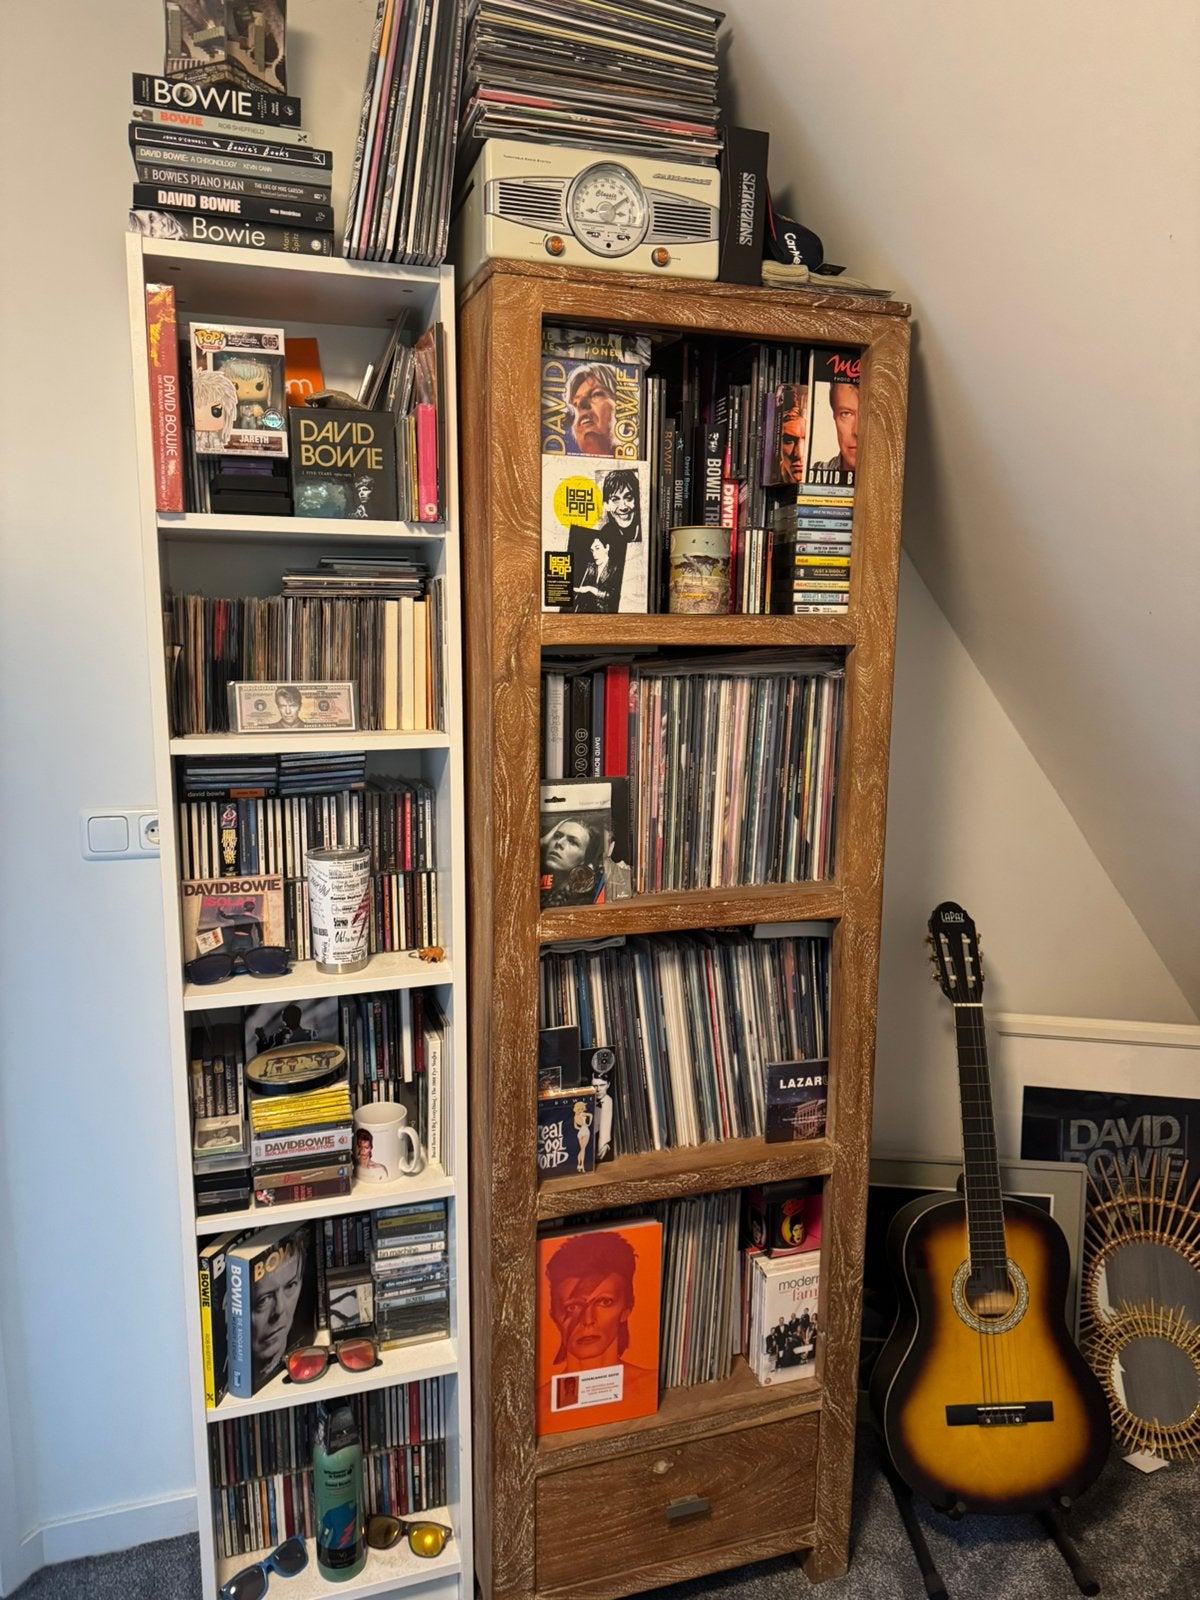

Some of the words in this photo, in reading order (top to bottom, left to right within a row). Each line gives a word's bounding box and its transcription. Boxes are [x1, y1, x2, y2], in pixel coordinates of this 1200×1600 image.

[154, 79, 252, 116] BOWIE
[160, 111, 203, 127] BOWIE
[218, 122, 231, 131] ROB
[232, 124, 265, 135] SHEFFIELD
[140, 148, 161, 158] DAVID
[196, 156, 238, 168] CHRONOLOGY
[263, 145, 289, 158] Books
[243, 163, 258, 171] KEVIN
[259, 165, 273, 173] CANN
[191, 174, 221, 188] PIANO
[224, 179, 244, 192] MAN
[158, 190, 196, 208] DAVID
[200, 195, 241, 215] BOWIE
[740, 172, 757, 246] SCORPIONS
[192, 216, 266, 247] Bowie
[195, 329, 225, 345] POP!
[263, 336, 278, 347] 365
[585, 347, 623, 358] JONES
[163, 375, 177, 412] DAVID
[543, 361, 566, 456] DAVID
[615, 367, 639, 460] BOWIE
[164, 414, 178, 456] BOWIE
[239, 434, 269, 444] JARETH
[300, 419, 374, 445] DAVID
[301, 444, 383, 470] BOWIE
[706, 458, 722, 502] BOWIE
[808, 470, 840, 484] DAVID
[675, 479, 684, 510] BOWIE
[188, 790, 205, 798] david
[184, 879, 281, 897] DAVIDBOWIE
[265, 1135, 335, 1153] DAVIDBOWIE
[1070, 1115, 1181, 1150] DAVID
[389, 1245, 419, 1257] machine
[201, 1273, 210, 1307] BOWIE
[231, 1264, 242, 1316] BOWIE
